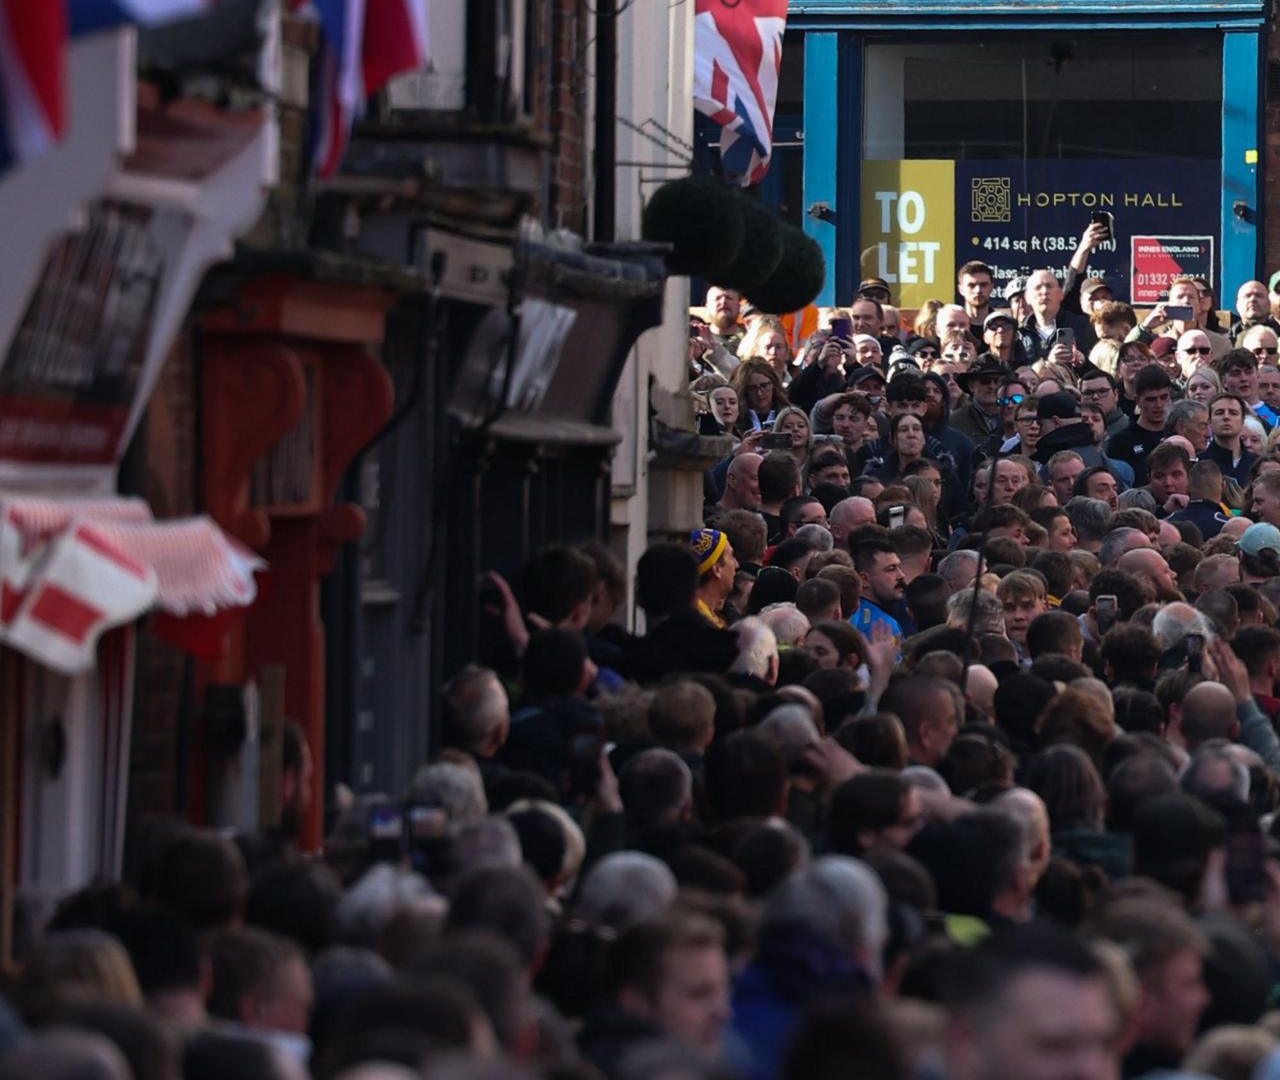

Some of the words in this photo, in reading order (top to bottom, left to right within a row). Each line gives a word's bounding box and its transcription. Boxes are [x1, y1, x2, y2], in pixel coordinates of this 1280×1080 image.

[1017, 192, 1114, 207] HOPTON
[1124, 192, 1183, 207] HALL
[874, 190, 926, 235] TO
[983, 236, 1010, 251] 414
[1012, 239, 1027, 254] sq
[1031, 235, 1040, 250] ft
[1043, 236, 1077, 252] (38.5
[878, 241, 941, 284] LET
[1086, 264, 1105, 279] for
[1137, 273, 1168, 286] 01332
